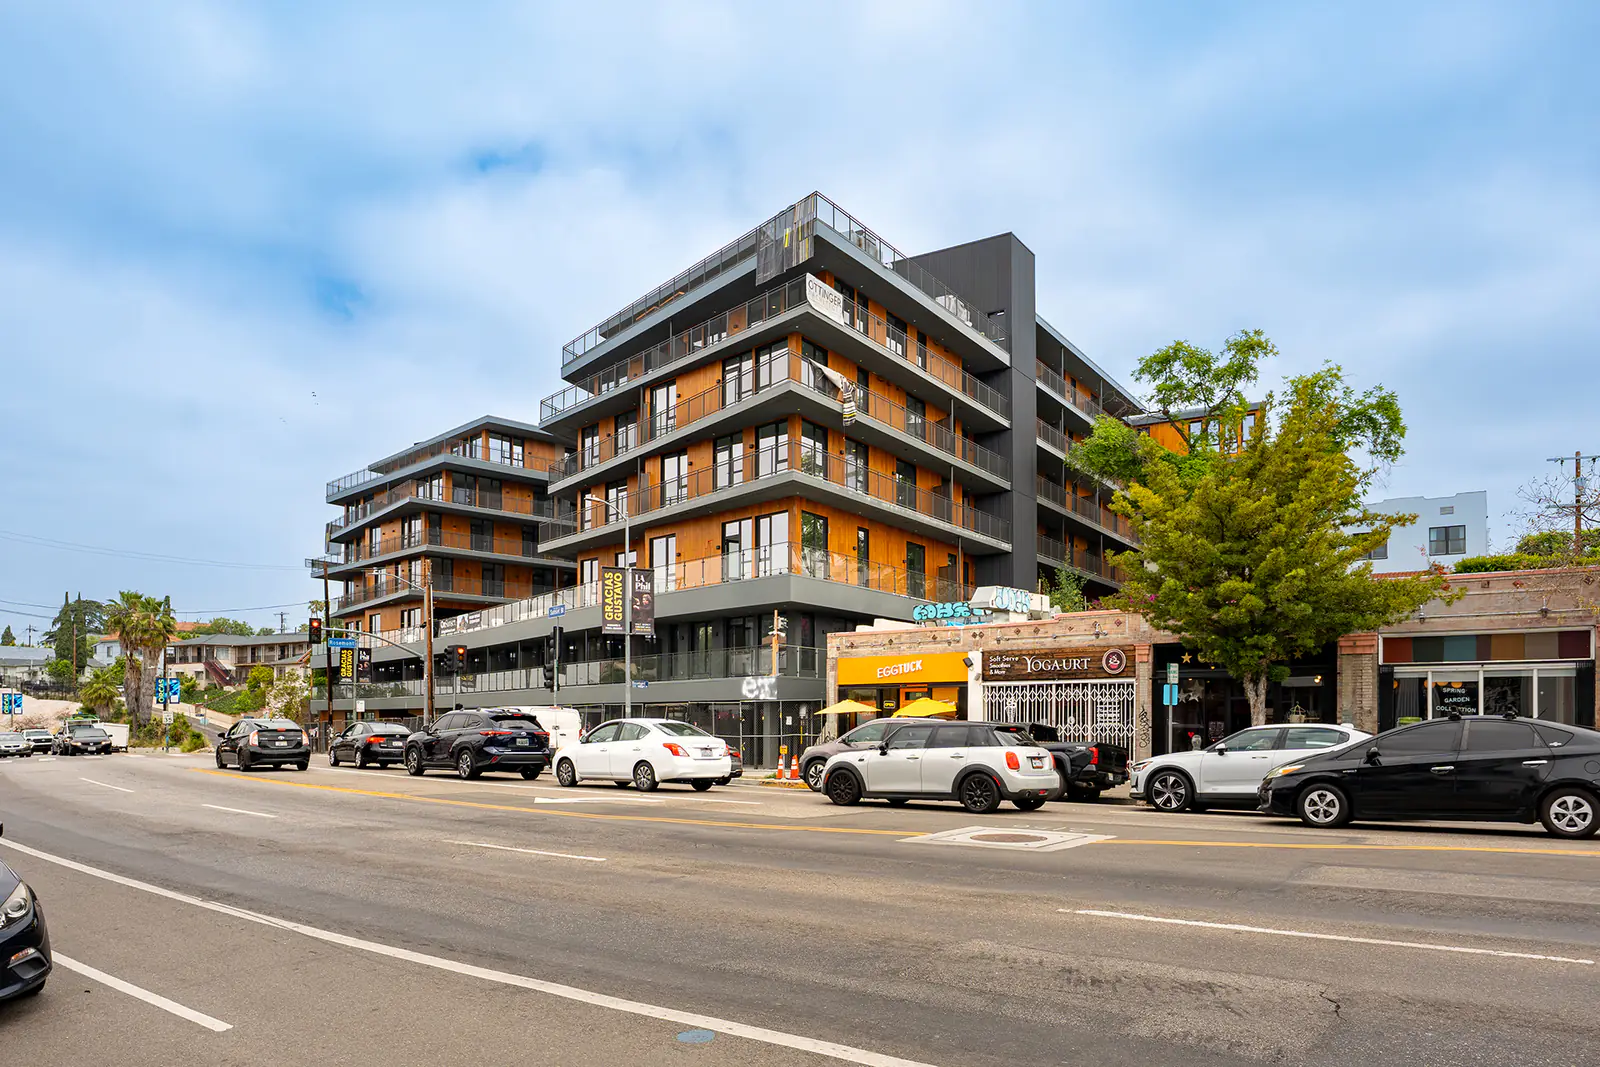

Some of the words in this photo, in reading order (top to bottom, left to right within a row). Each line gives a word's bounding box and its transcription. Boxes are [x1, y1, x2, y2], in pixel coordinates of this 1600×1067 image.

[808, 280, 842, 308] OTTINGER
[635, 574, 644, 582] LA
[635, 582, 650, 590] Phil
[604, 572, 613, 620] GRACIAS
[614, 572, 622, 620] GUSTAVO
[877, 660, 923, 678] EGGTUCK
